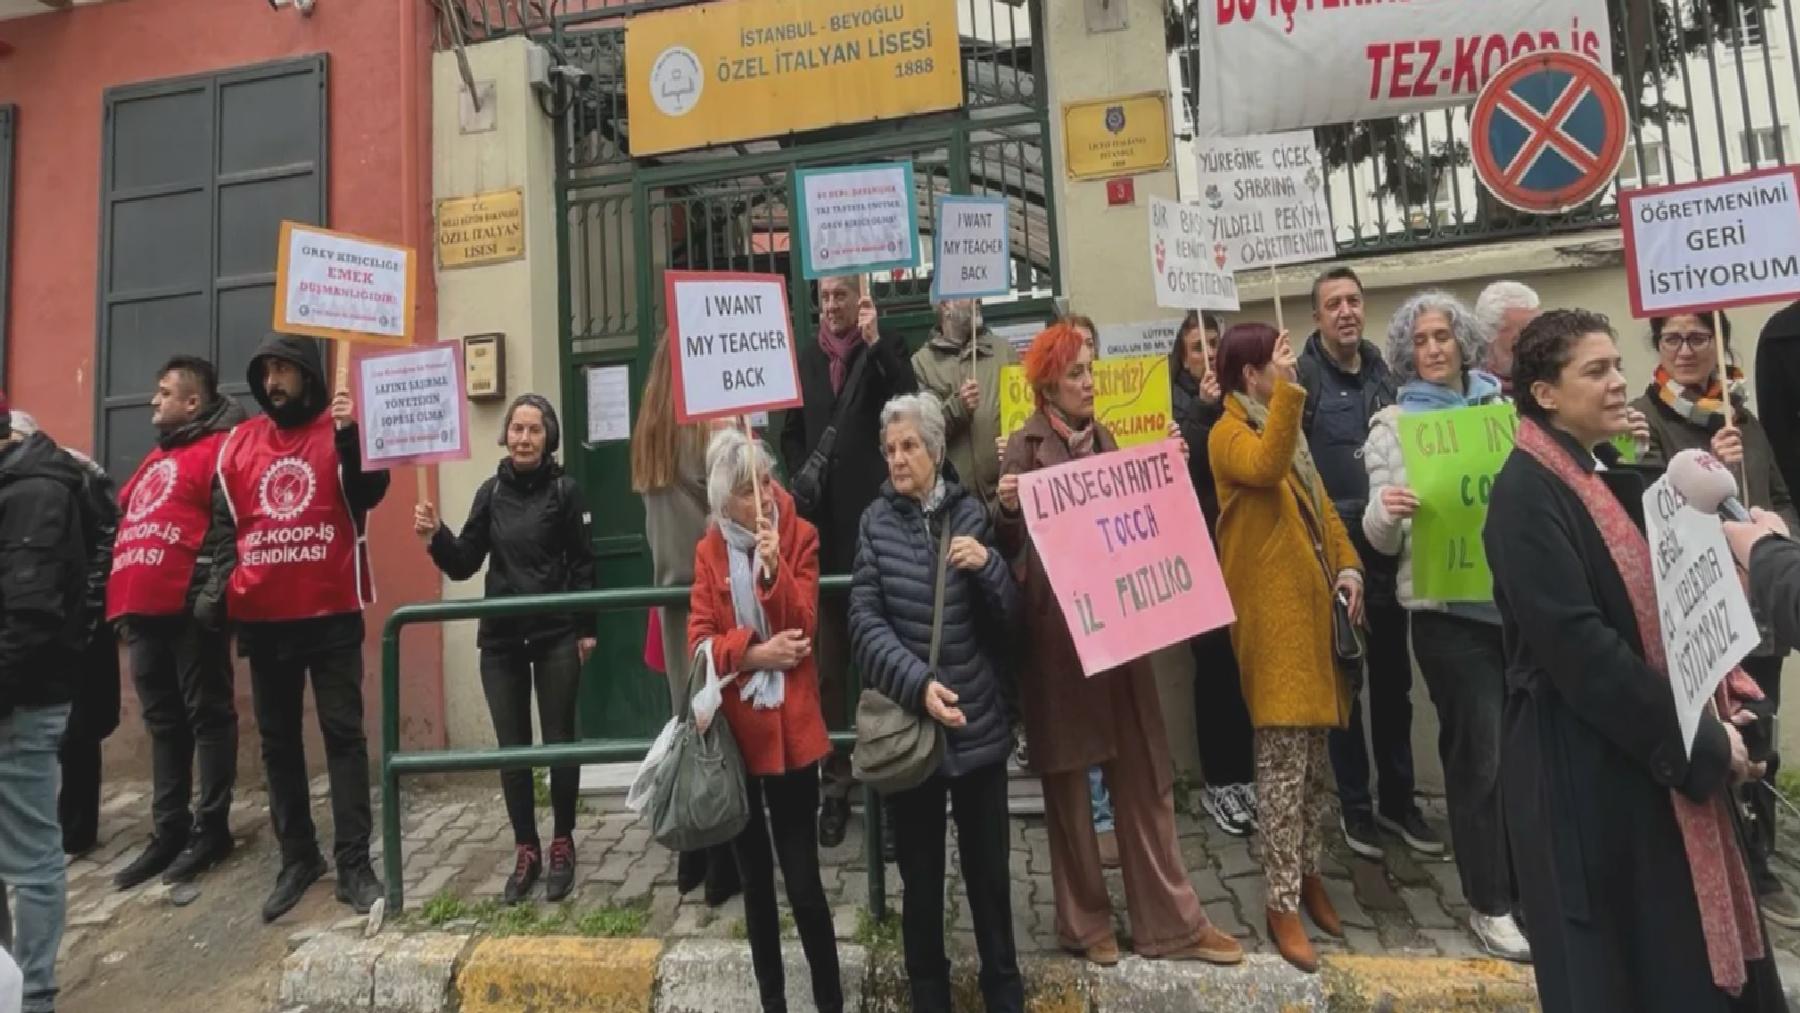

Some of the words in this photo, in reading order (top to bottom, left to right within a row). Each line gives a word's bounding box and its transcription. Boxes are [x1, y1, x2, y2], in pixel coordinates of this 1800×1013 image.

[740, 23, 817, 48] İSTANBUL
[830, 3, 904, 32] BEYOĞLU
[717, 57, 769, 83] ÖZEL
[775, 40, 861, 74] İTALYAN
[868, 22, 933, 57] LİSESİ
[895, 57, 934, 79] 1888
[1116, 183, 1125, 198] 3
[1641, 181, 1788, 223] ÖĞRETMENİMİ
[958, 213, 962, 228] I
[962, 212, 992, 229] WANT
[944, 240, 960, 255] MY
[962, 238, 1003, 255] TEACHER
[1686, 219, 1746, 251] GERİ
[301, 246, 335, 260] GREV
[328, 266, 375, 285] EMEK
[961, 265, 988, 281] BACK
[1650, 255, 1799, 295] İSTİYORUM
[705, 295, 711, 317] I
[714, 294, 763, 317] WANT
[686, 334, 714, 357] MY
[719, 329, 787, 354] TEACHER
[722, 367, 766, 391] BACK
[1415, 419, 1458, 457] GLI
[242, 544, 327, 567] SENDİKASI
